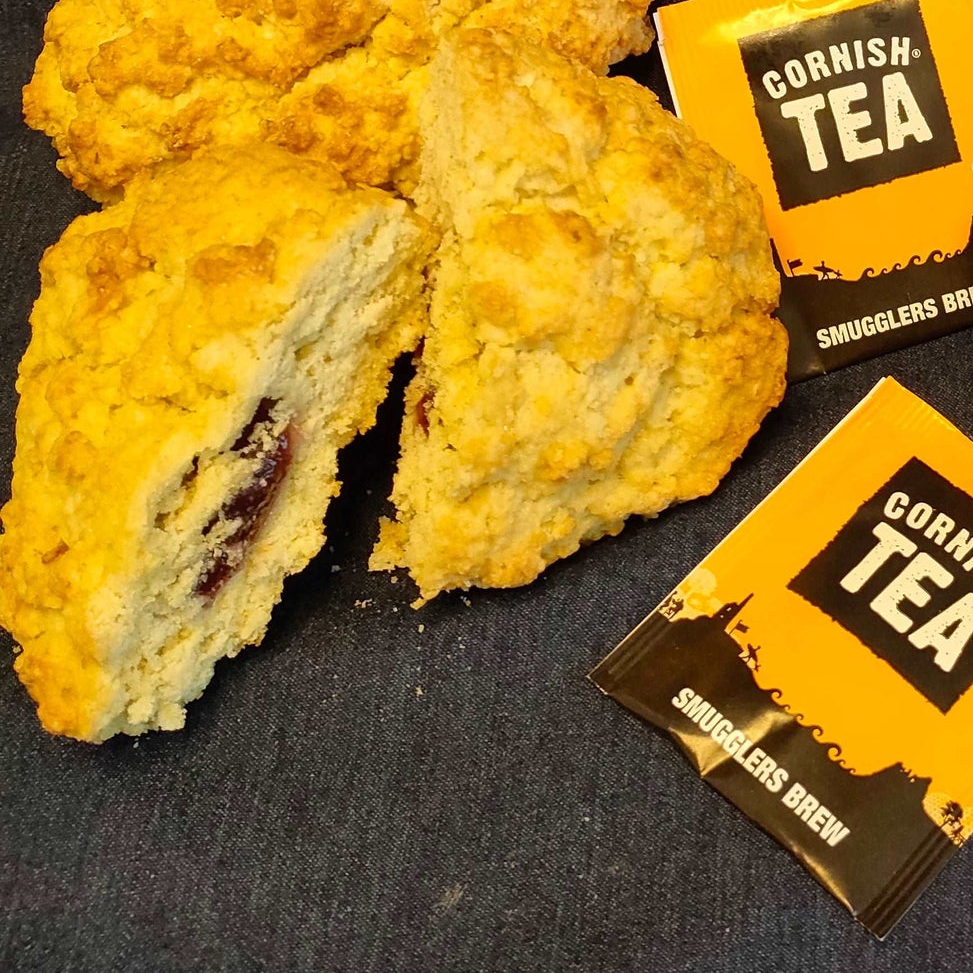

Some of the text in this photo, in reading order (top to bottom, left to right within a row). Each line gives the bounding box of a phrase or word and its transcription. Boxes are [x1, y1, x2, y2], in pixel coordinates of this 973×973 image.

[780, 71, 933, 172] TEA
[816, 298, 938, 349] SMUGGLERS
[671, 687, 851, 847] SMUGGLERS BREW
